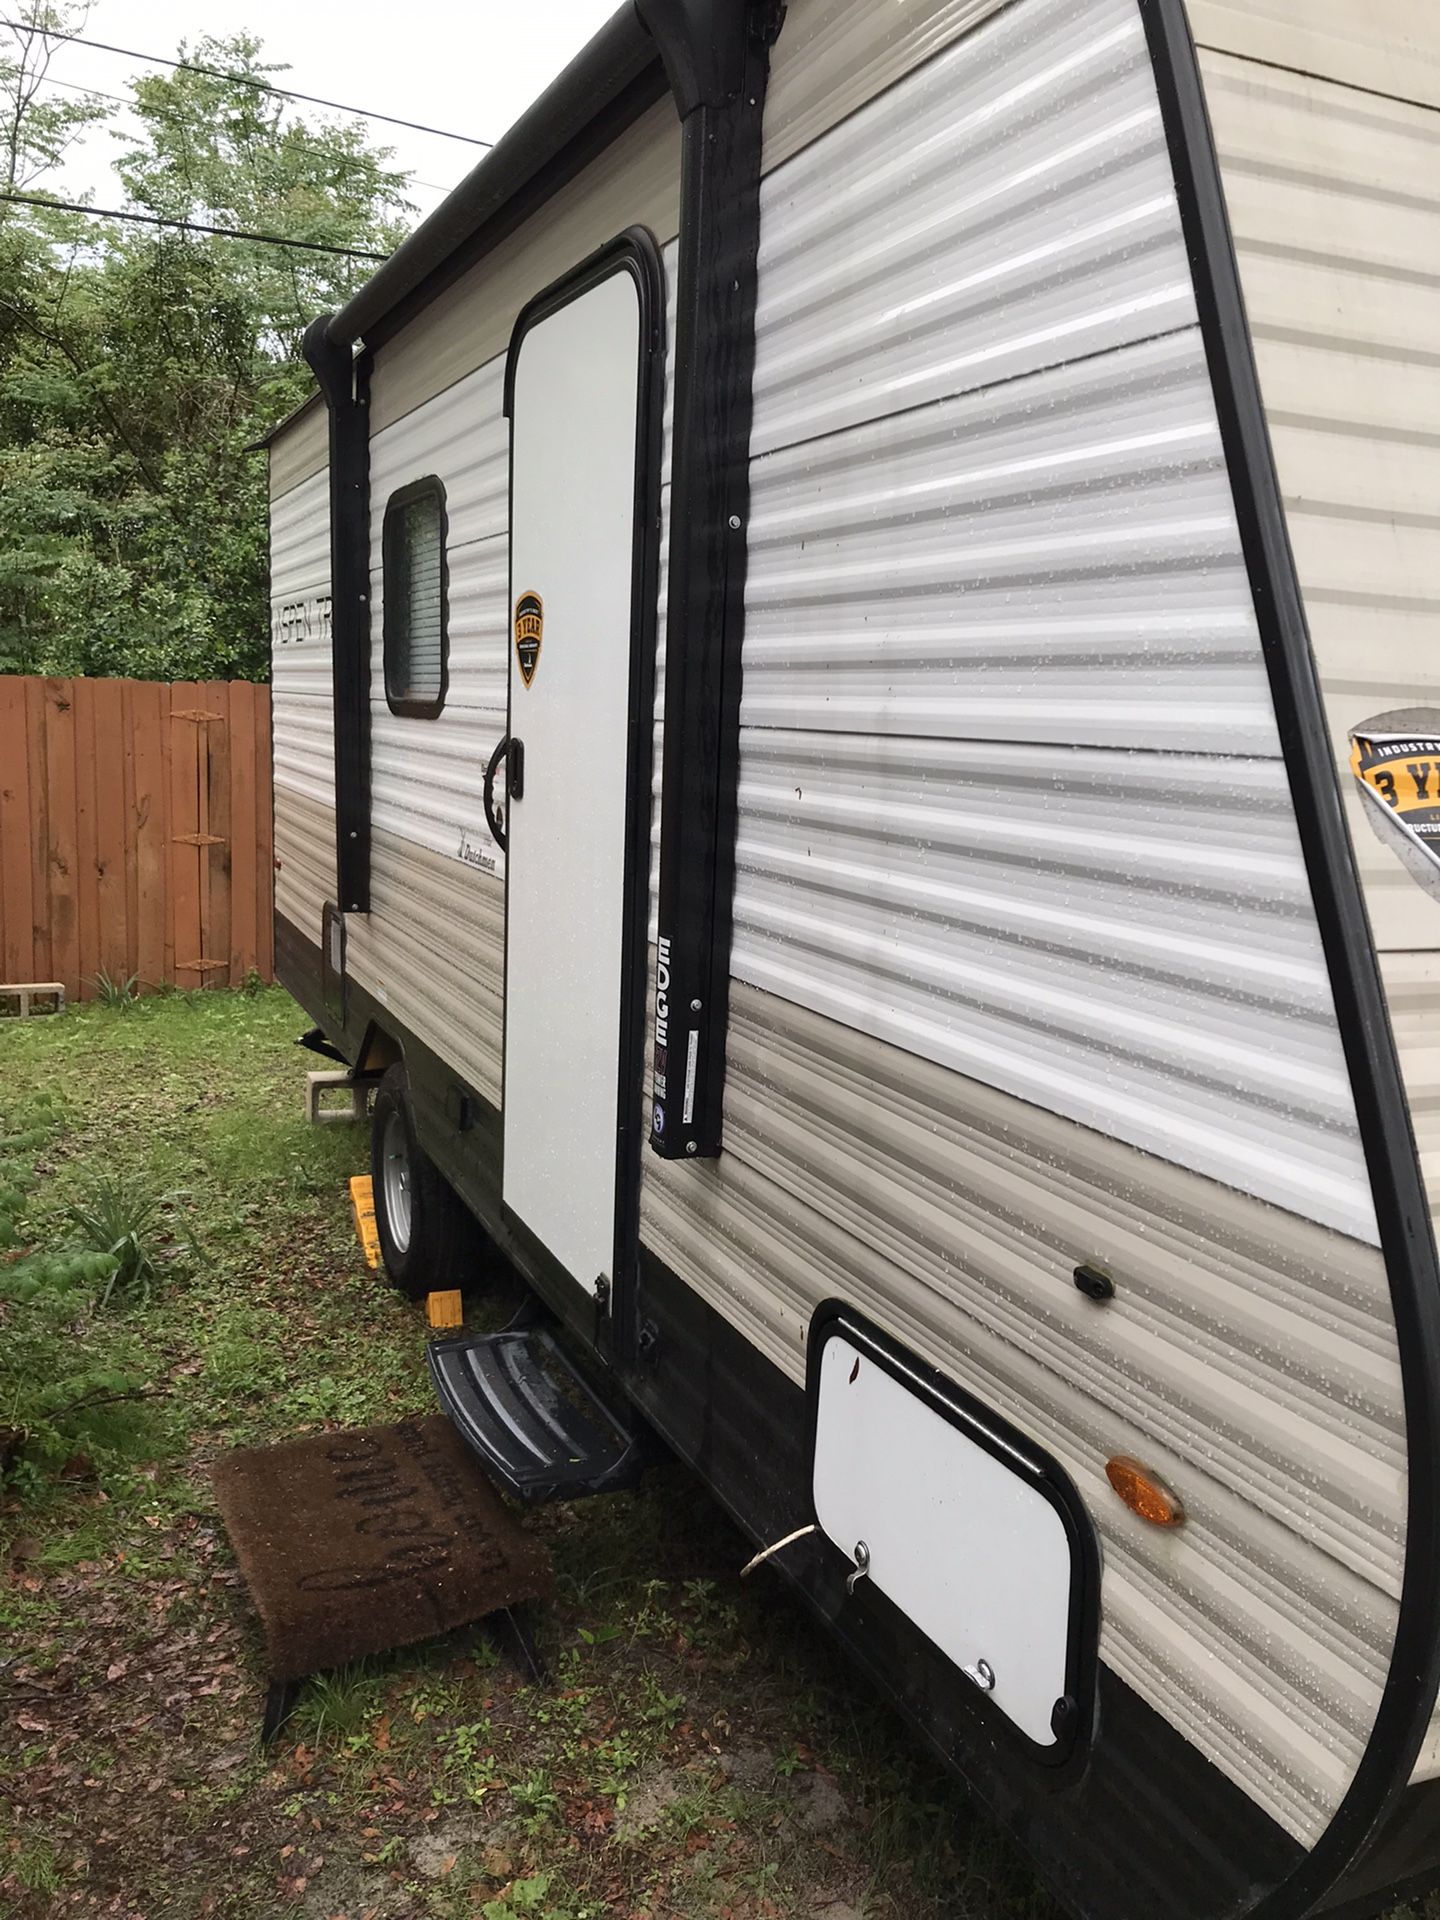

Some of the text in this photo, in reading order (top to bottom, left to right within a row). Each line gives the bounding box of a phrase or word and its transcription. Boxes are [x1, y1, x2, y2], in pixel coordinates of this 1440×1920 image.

[1374, 763, 1440, 808] 3 Y
[655, 936, 671, 1047] EDGE
